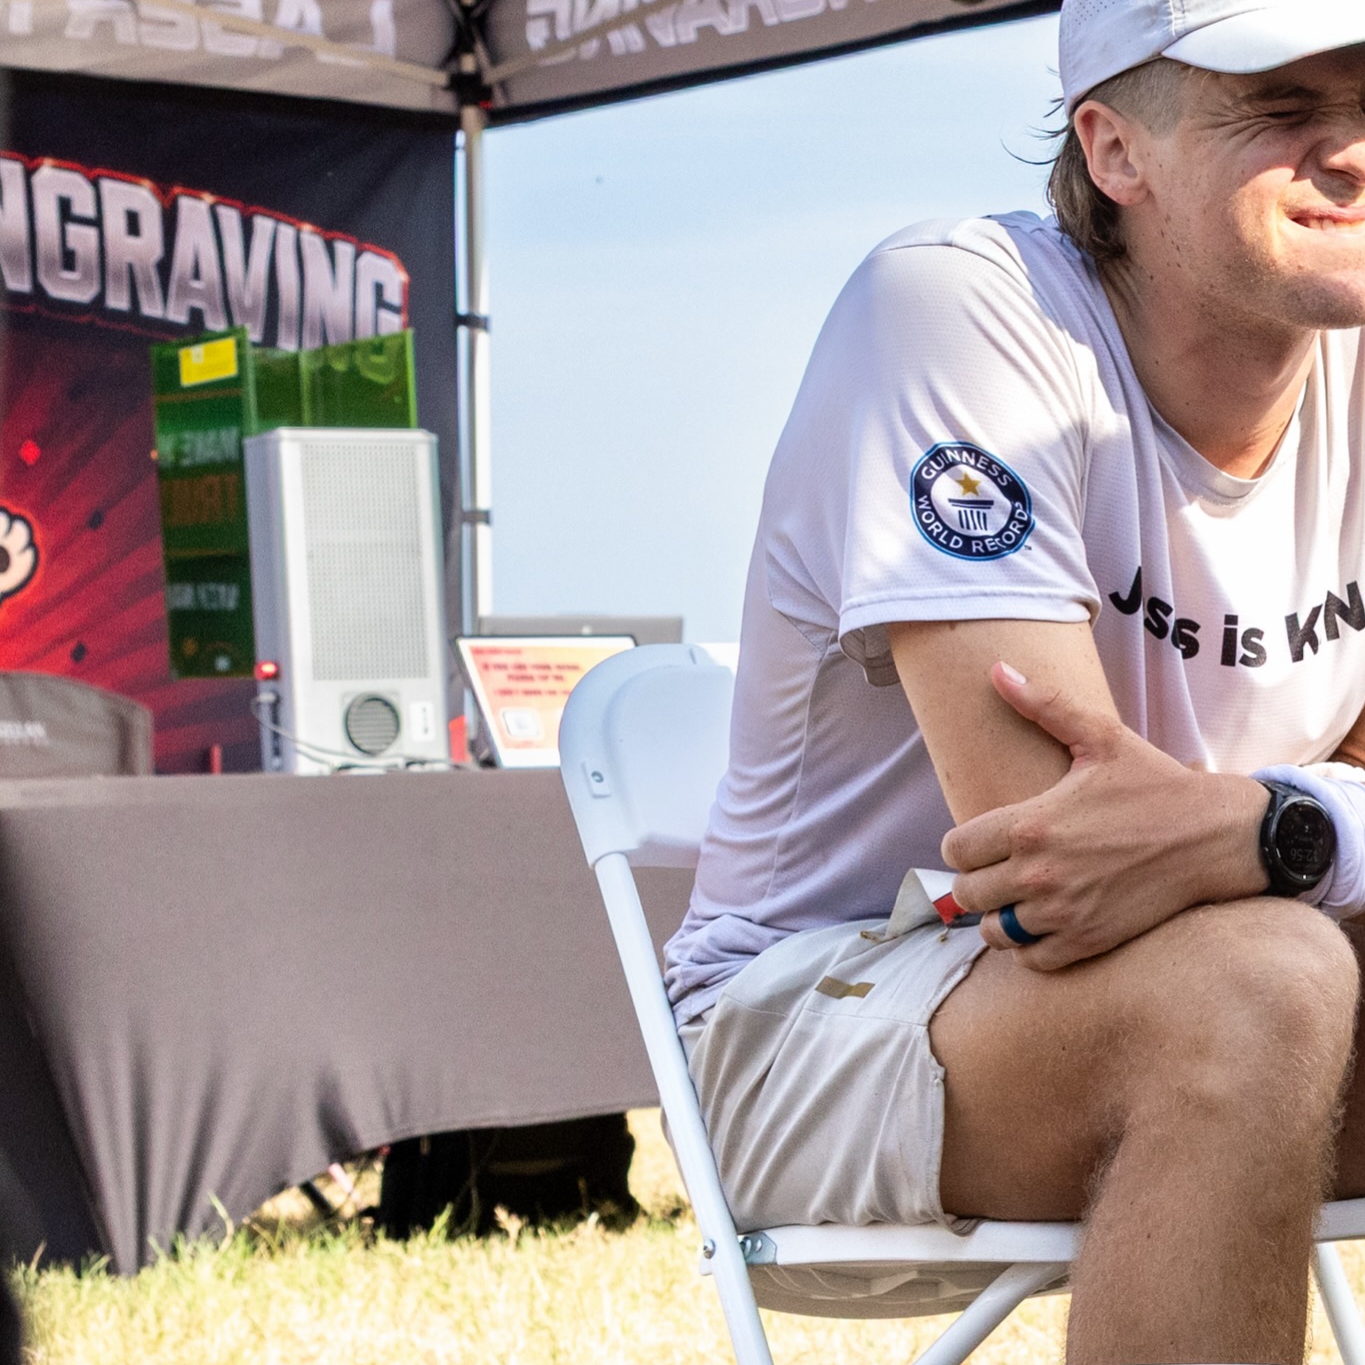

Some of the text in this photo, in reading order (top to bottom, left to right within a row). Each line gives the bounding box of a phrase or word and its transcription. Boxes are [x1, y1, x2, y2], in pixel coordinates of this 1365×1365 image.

[921, 449, 1012, 487] GUINNESS
[919, 495, 963, 549] WORLD
[1221, 614, 1267, 668] is
